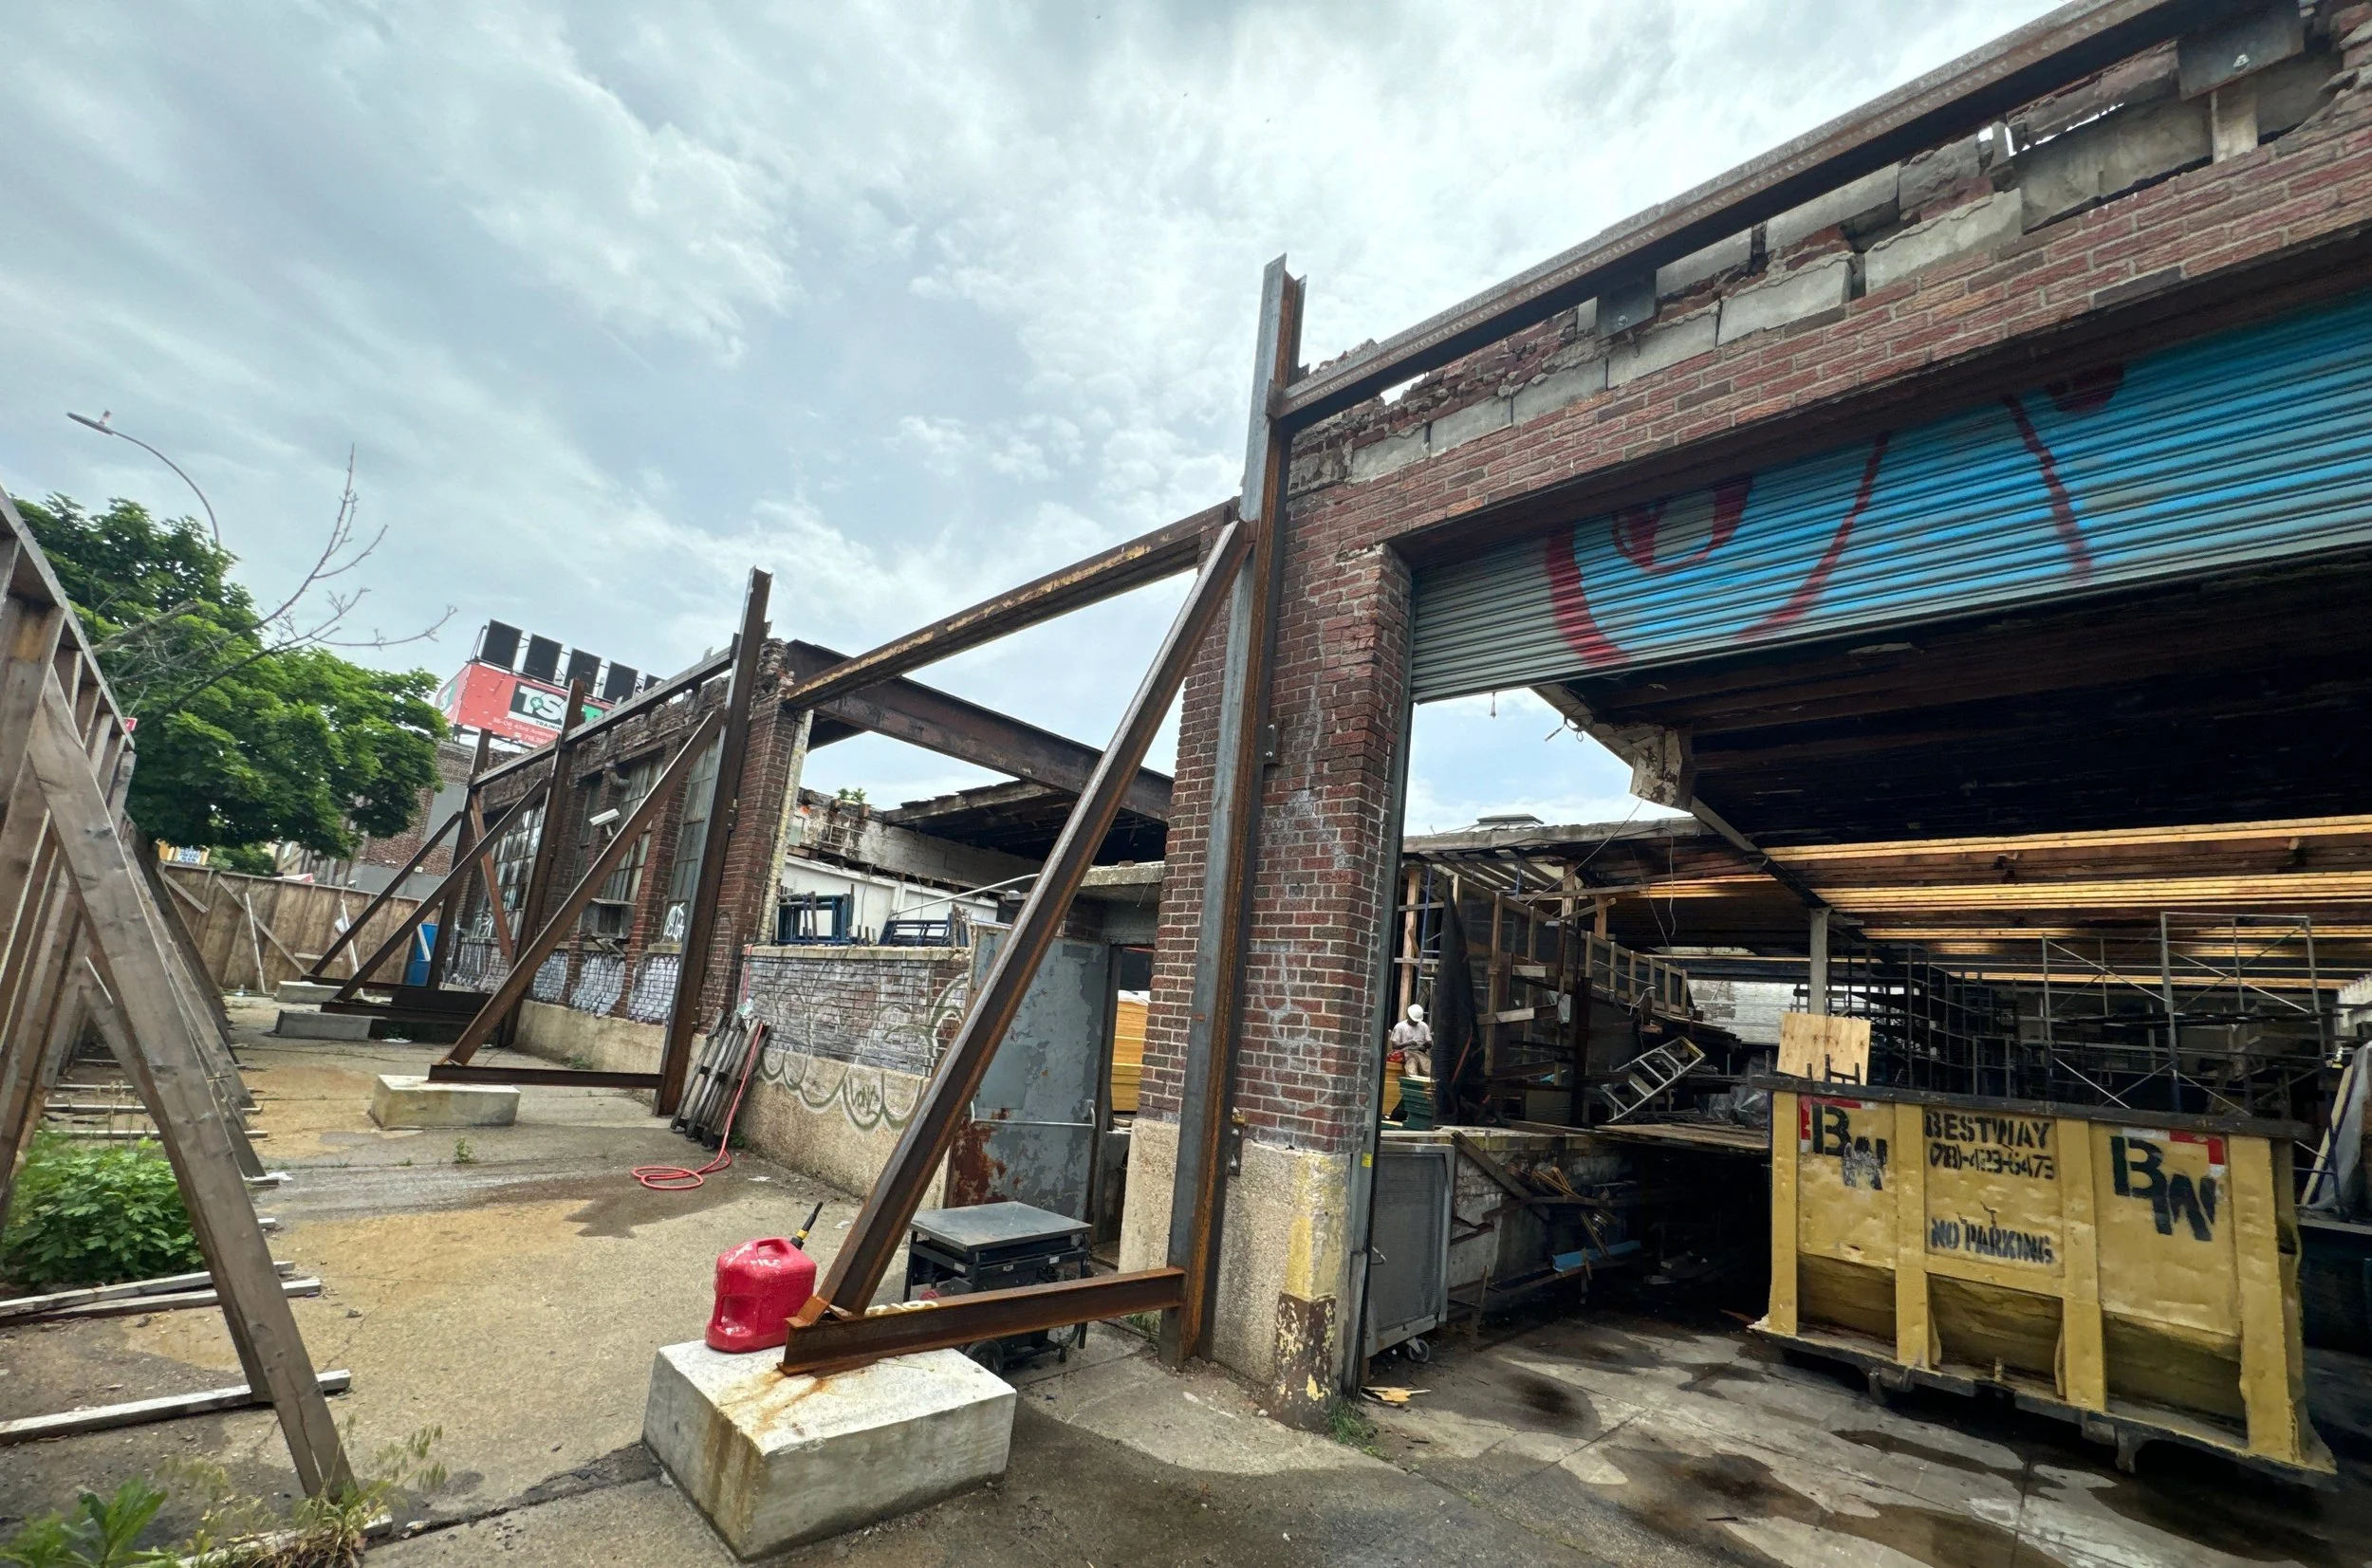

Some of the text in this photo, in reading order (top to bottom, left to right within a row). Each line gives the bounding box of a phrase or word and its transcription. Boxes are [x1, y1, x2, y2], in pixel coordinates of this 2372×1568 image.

[518, 684, 567, 721] TS
[535, 720, 562, 731] TRAININ
[1924, 1111, 2050, 1150] BESTWAY
[2109, 1135, 2217, 1243] BW
[1931, 1217, 2055, 1265] NO PARKING
